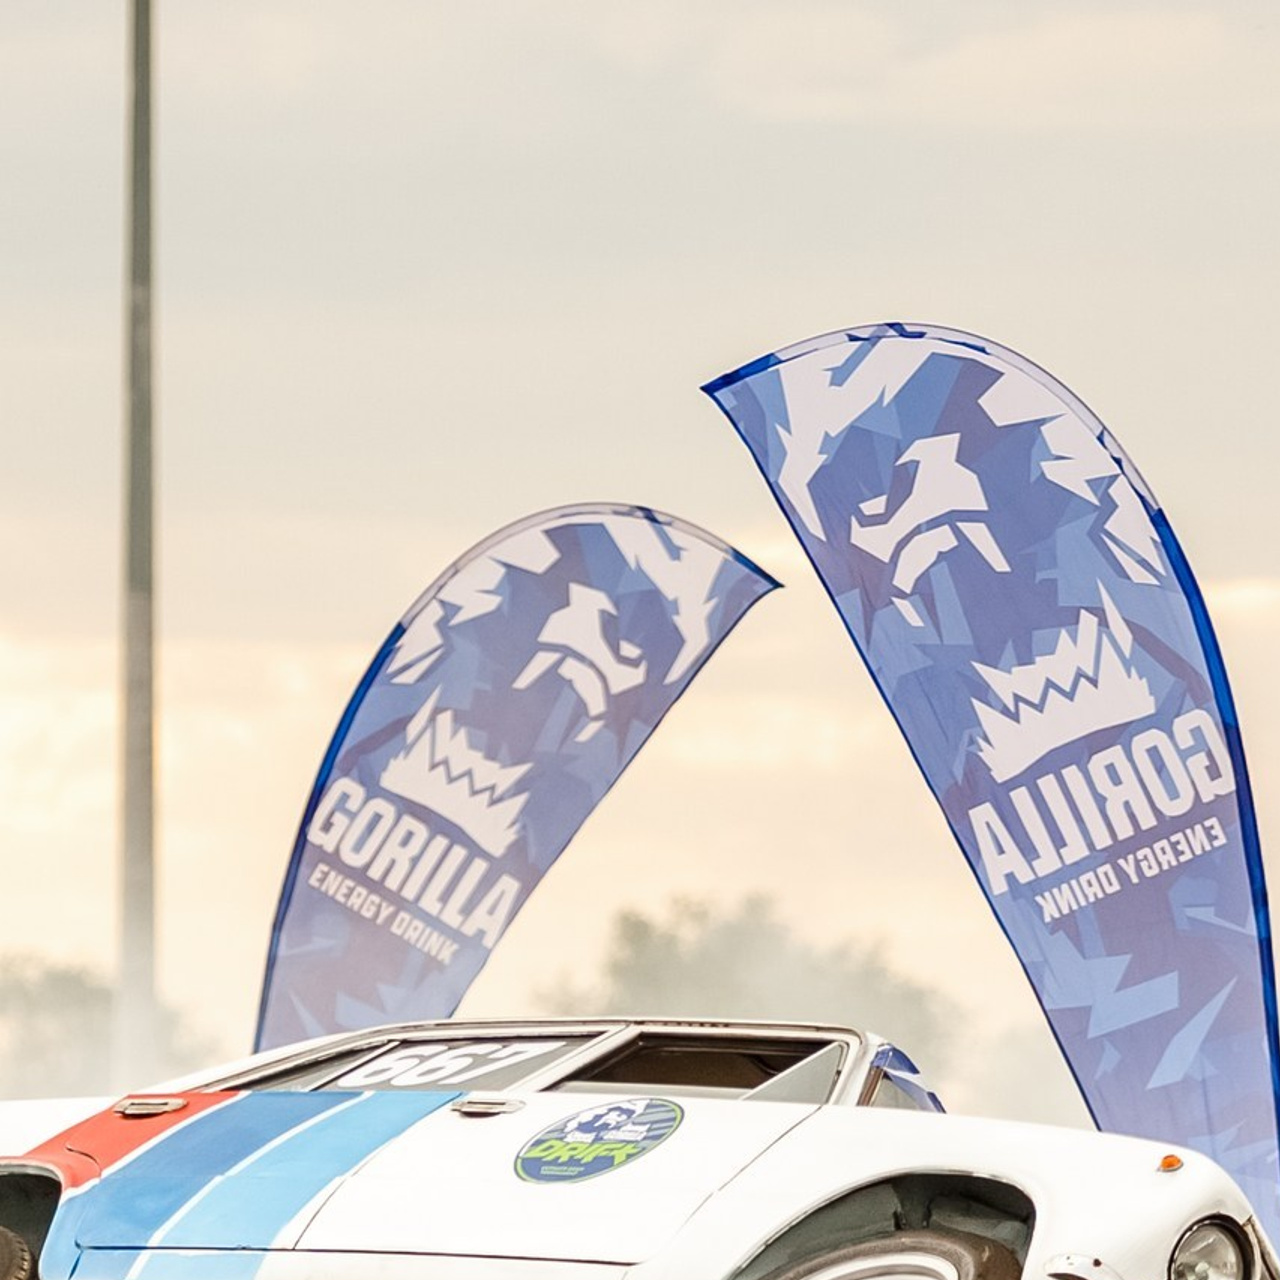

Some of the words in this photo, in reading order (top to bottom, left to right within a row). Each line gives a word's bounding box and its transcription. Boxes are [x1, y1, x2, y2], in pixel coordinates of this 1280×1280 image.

[307, 777, 521, 950] GORILLA
[308, 862, 396, 925] ENERGY
[389, 910, 460, 966] DRINK
[336, 1042, 567, 1088] 667
[521, 1139, 640, 1165] DRIFT
